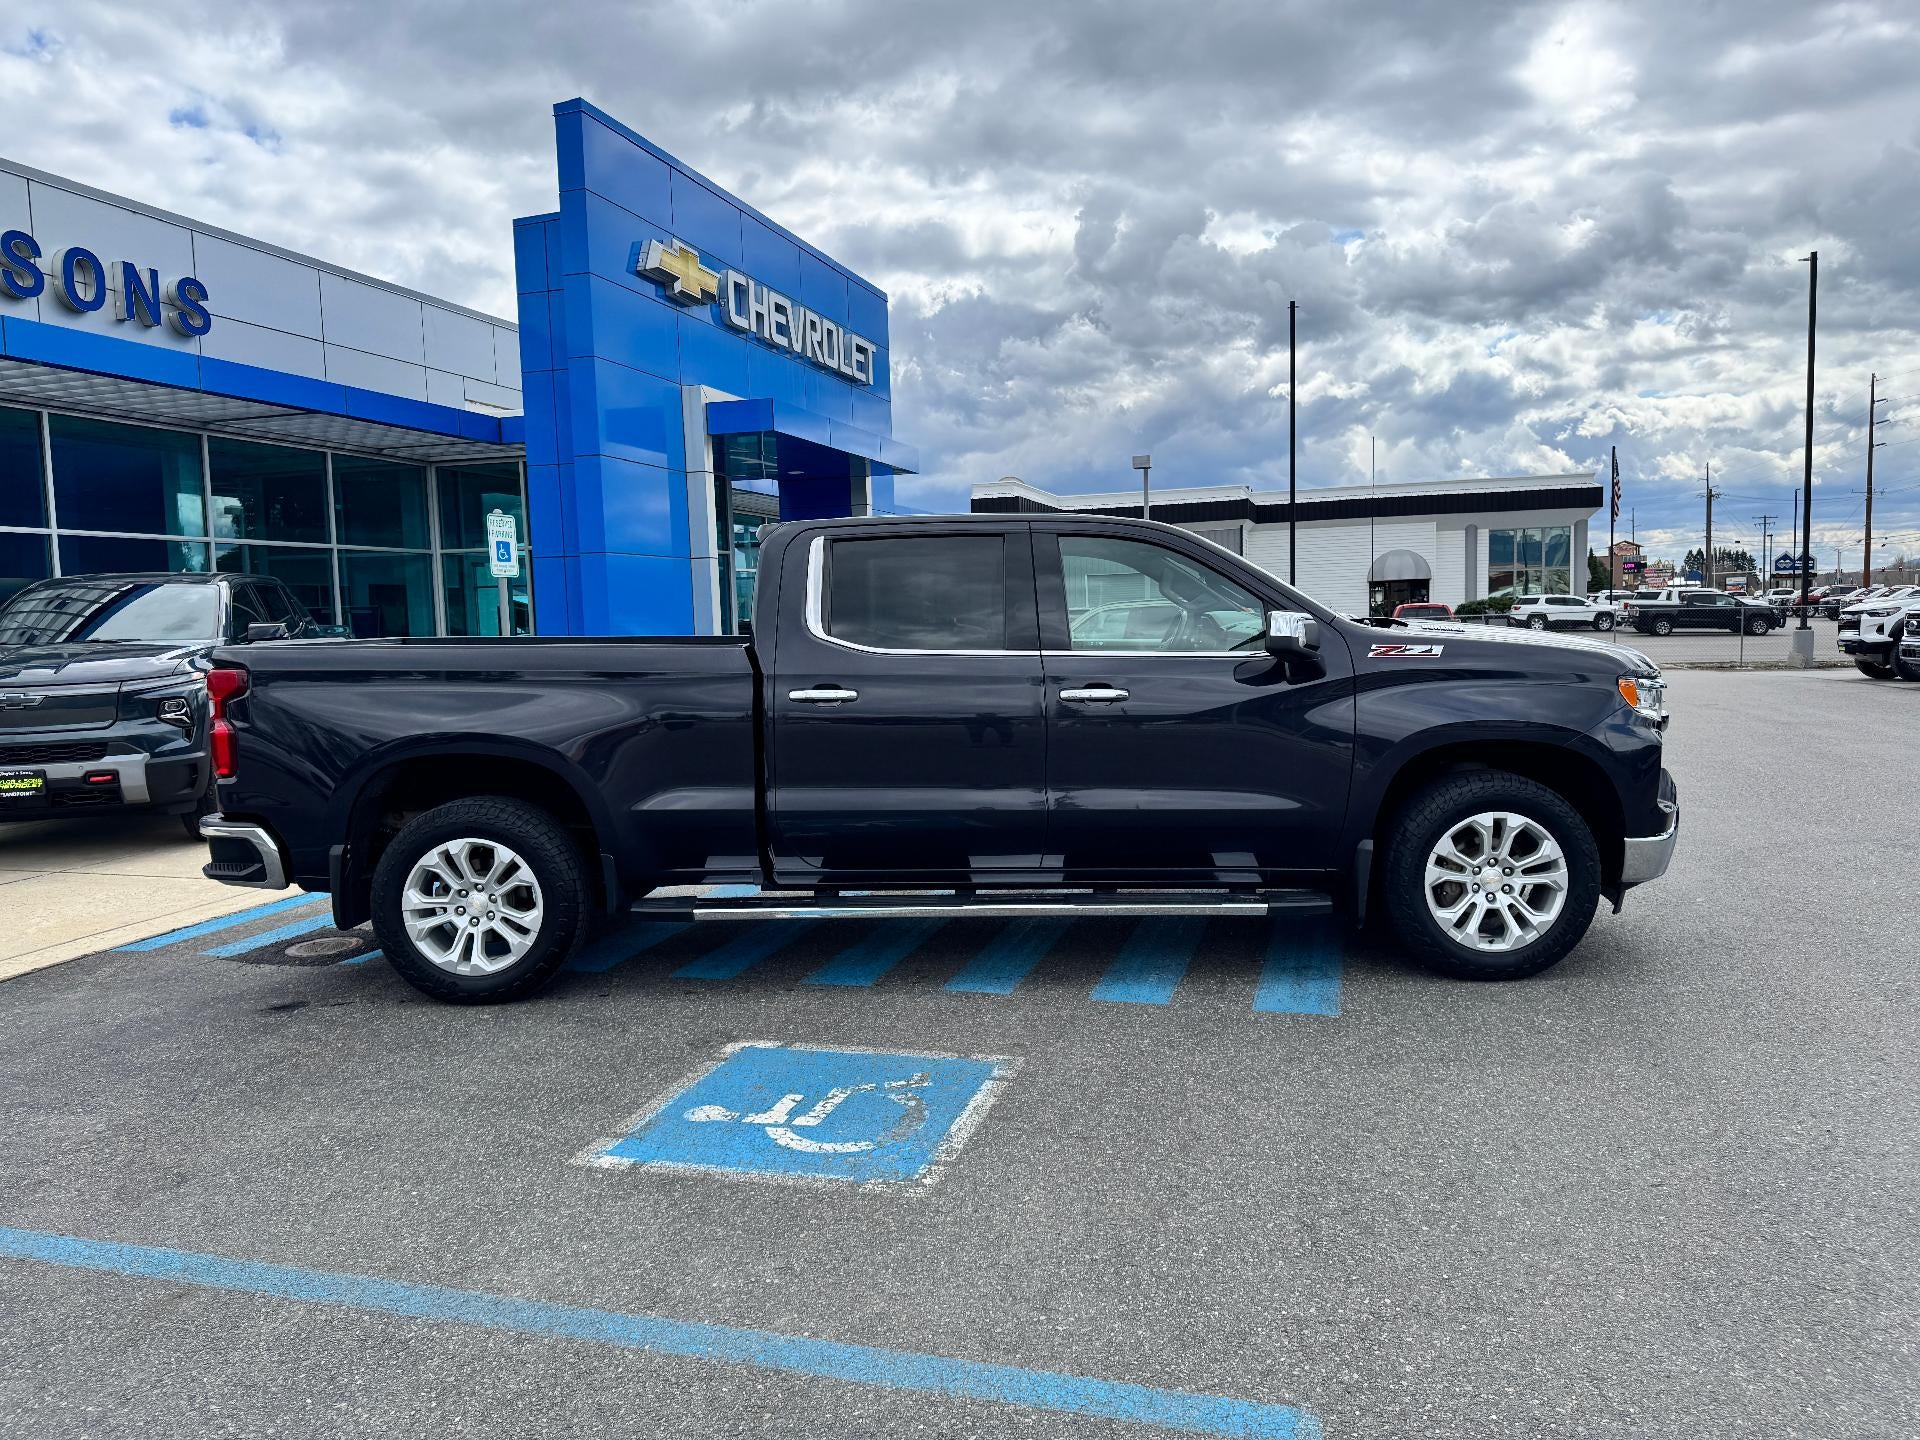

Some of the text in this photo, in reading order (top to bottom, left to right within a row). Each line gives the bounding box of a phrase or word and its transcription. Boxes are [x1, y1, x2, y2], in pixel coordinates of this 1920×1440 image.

[0, 230, 211, 336] SONS
[721, 270, 876, 385] CHEVROLET
[1367, 644, 1444, 658] Z71
